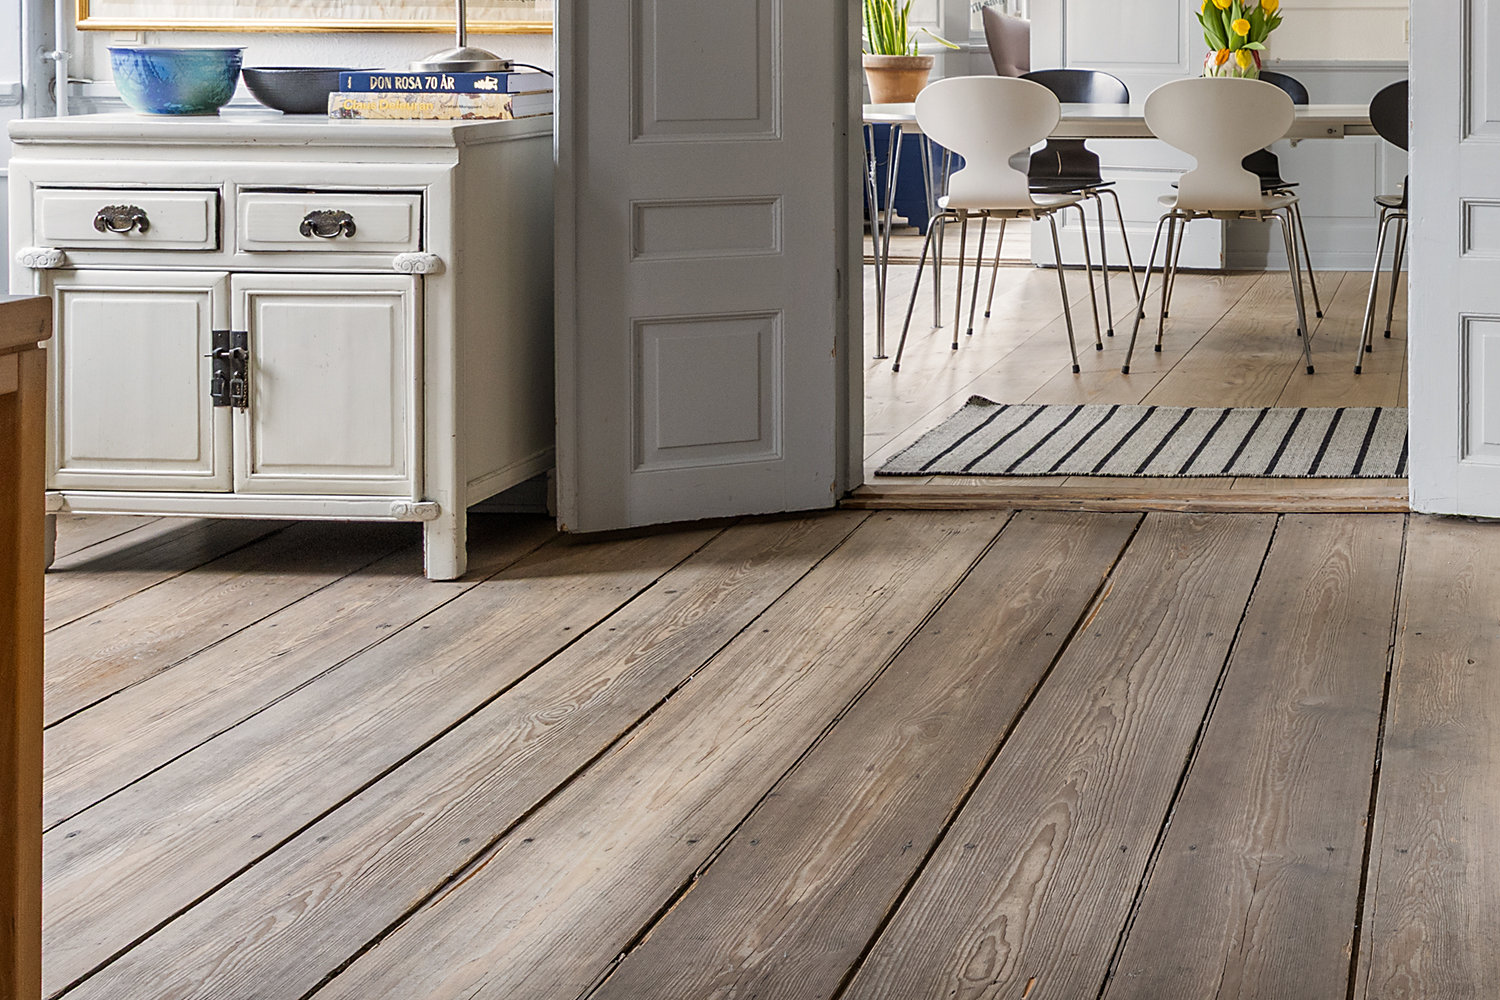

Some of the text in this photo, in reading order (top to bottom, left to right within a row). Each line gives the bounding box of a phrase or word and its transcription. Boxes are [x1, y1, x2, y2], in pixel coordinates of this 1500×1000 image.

[370, 73, 455, 90] DON ROSA 70 ÅR
[343, 99, 377, 110] Claus
